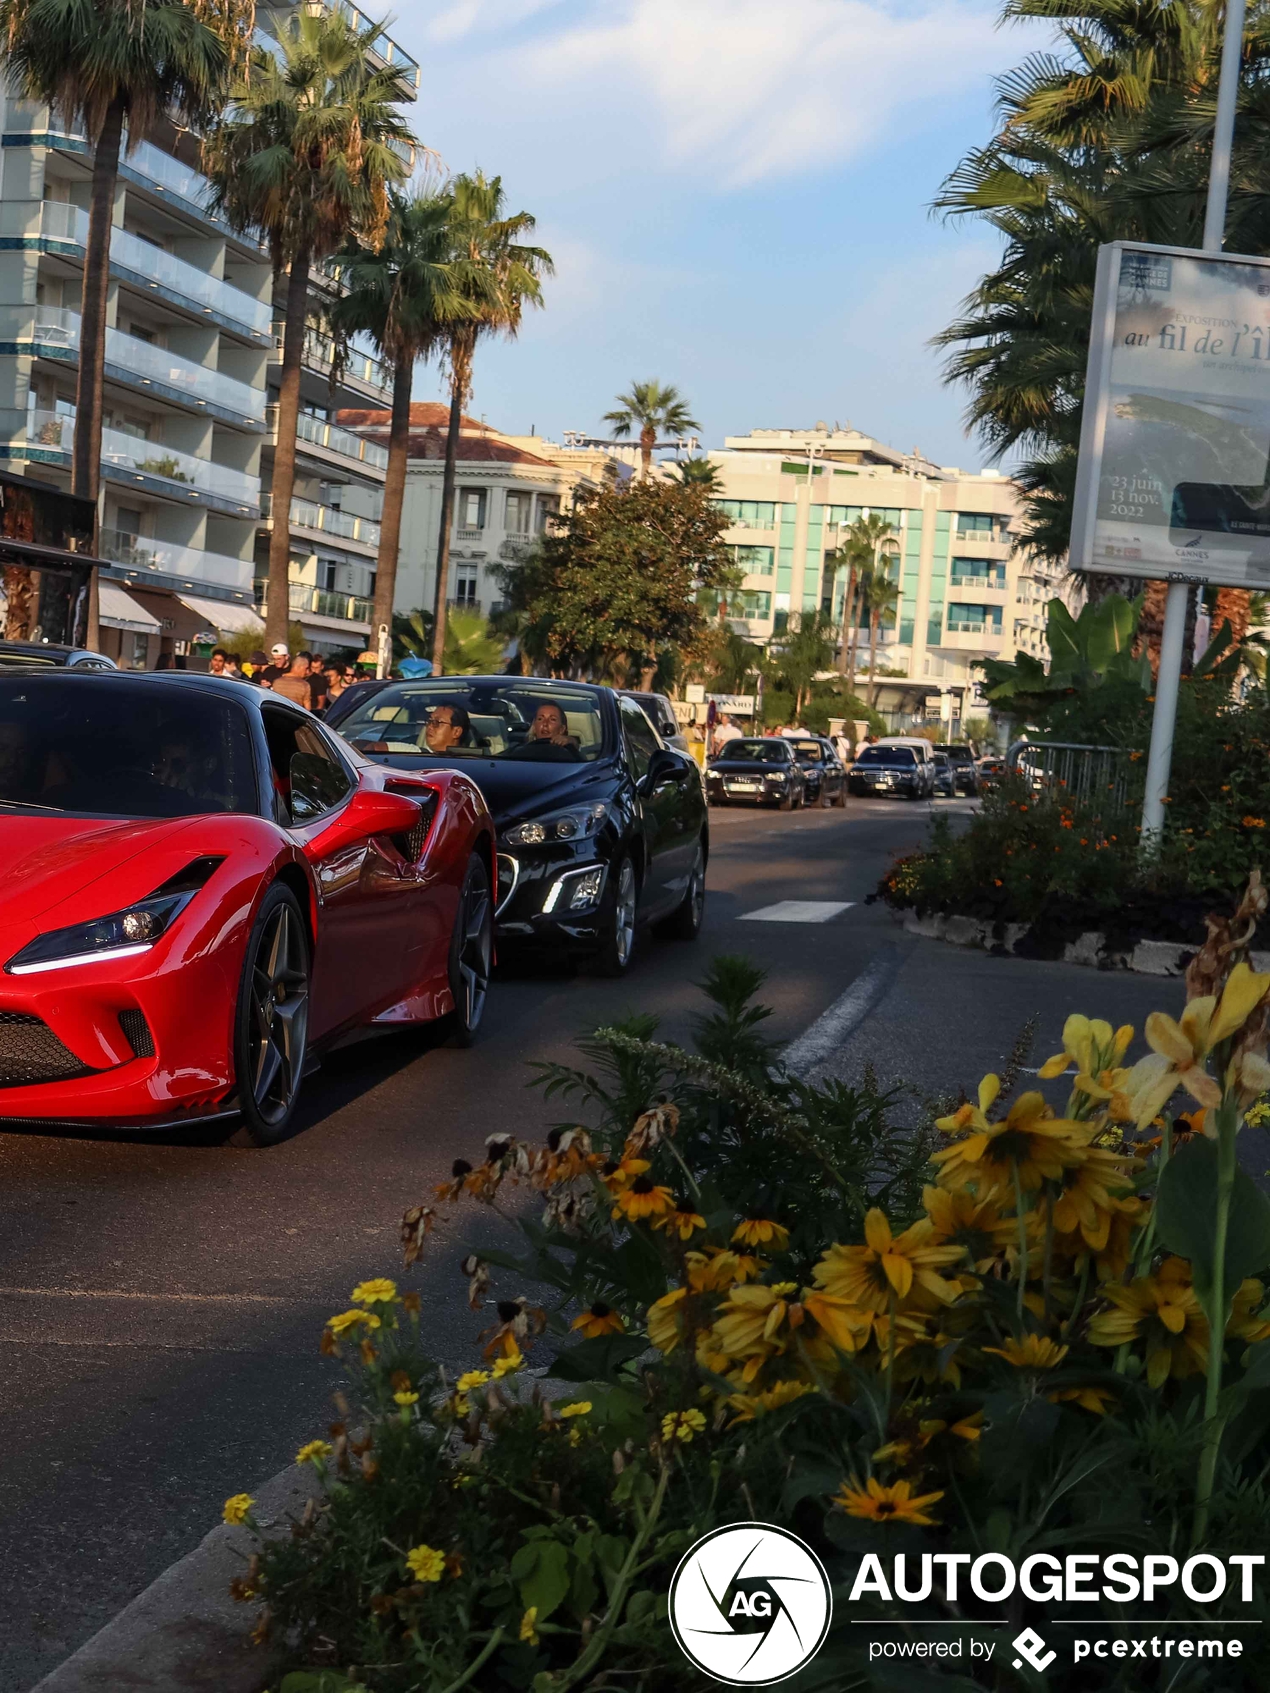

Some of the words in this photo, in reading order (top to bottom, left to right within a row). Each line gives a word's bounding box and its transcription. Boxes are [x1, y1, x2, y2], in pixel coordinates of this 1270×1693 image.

[1175, 313, 1237, 328] EXPOSITION
[1124, 331, 1150, 347] au
[1158, 323, 1187, 352] fil
[1193, 329, 1224, 355] de
[1111, 475, 1128, 490] 23
[1130, 474, 1162, 492] juin
[1111, 490, 1125, 504] 13
[1128, 492, 1159, 505] nov.
[1110, 503, 1145, 518] 2022
[1175, 549, 1210, 560] CANNES
[1164, 571, 1210, 584] JCDecaux
